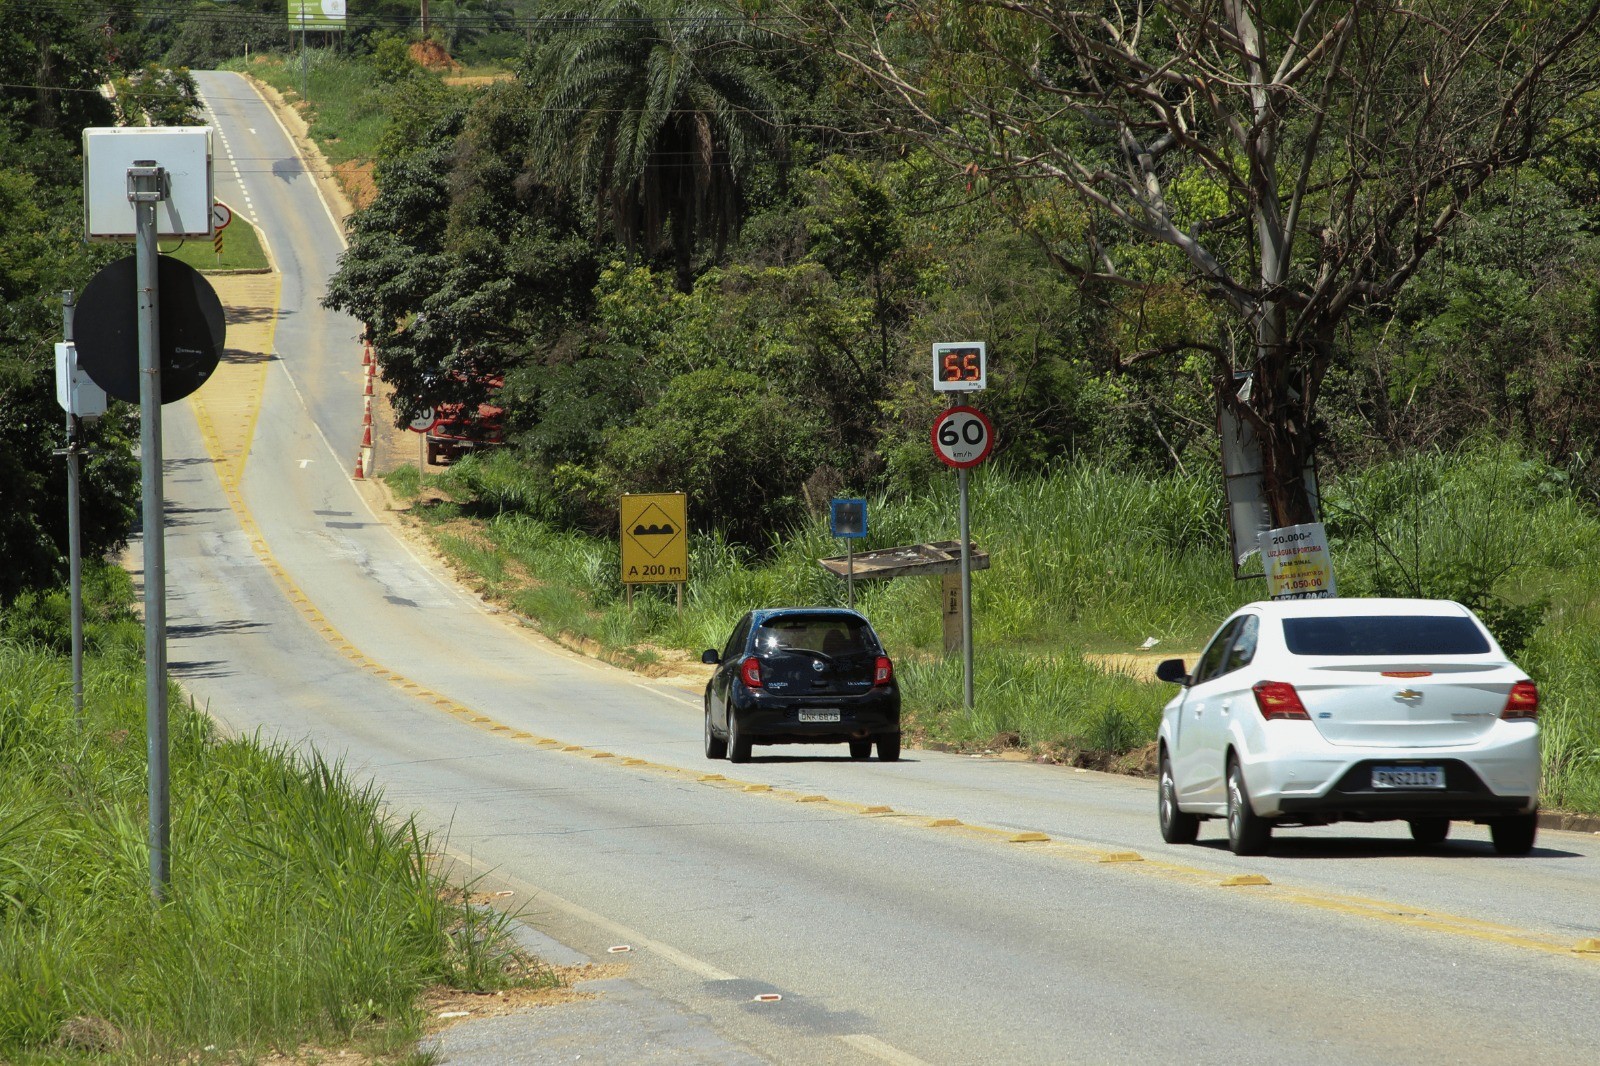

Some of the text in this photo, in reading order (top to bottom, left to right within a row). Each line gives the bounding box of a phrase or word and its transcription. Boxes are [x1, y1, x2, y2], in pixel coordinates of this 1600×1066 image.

[944, 354, 979, 381] 55
[939, 420, 984, 446] 60
[628, 564, 681, 576] A 200 m
